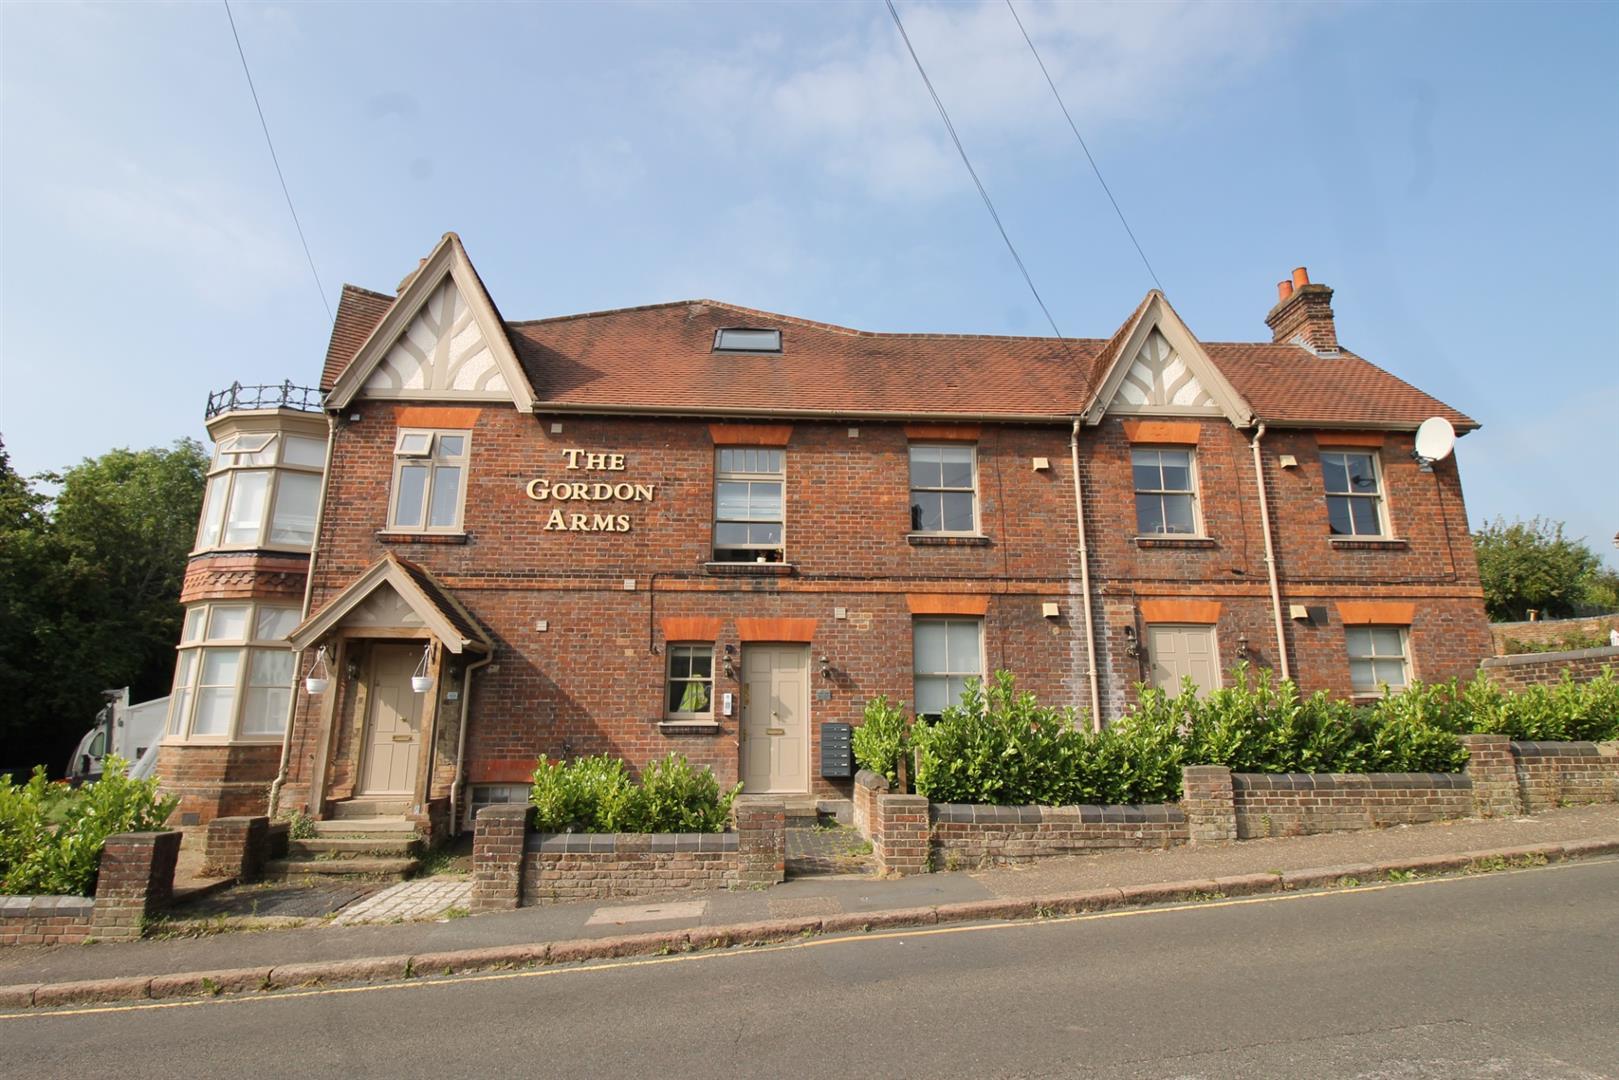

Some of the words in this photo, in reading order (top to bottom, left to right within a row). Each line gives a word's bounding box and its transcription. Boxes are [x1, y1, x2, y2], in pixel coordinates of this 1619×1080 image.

[562, 449, 625, 470] THE
[526, 479, 655, 501] GORDON
[543, 509, 631, 532] ARMS
